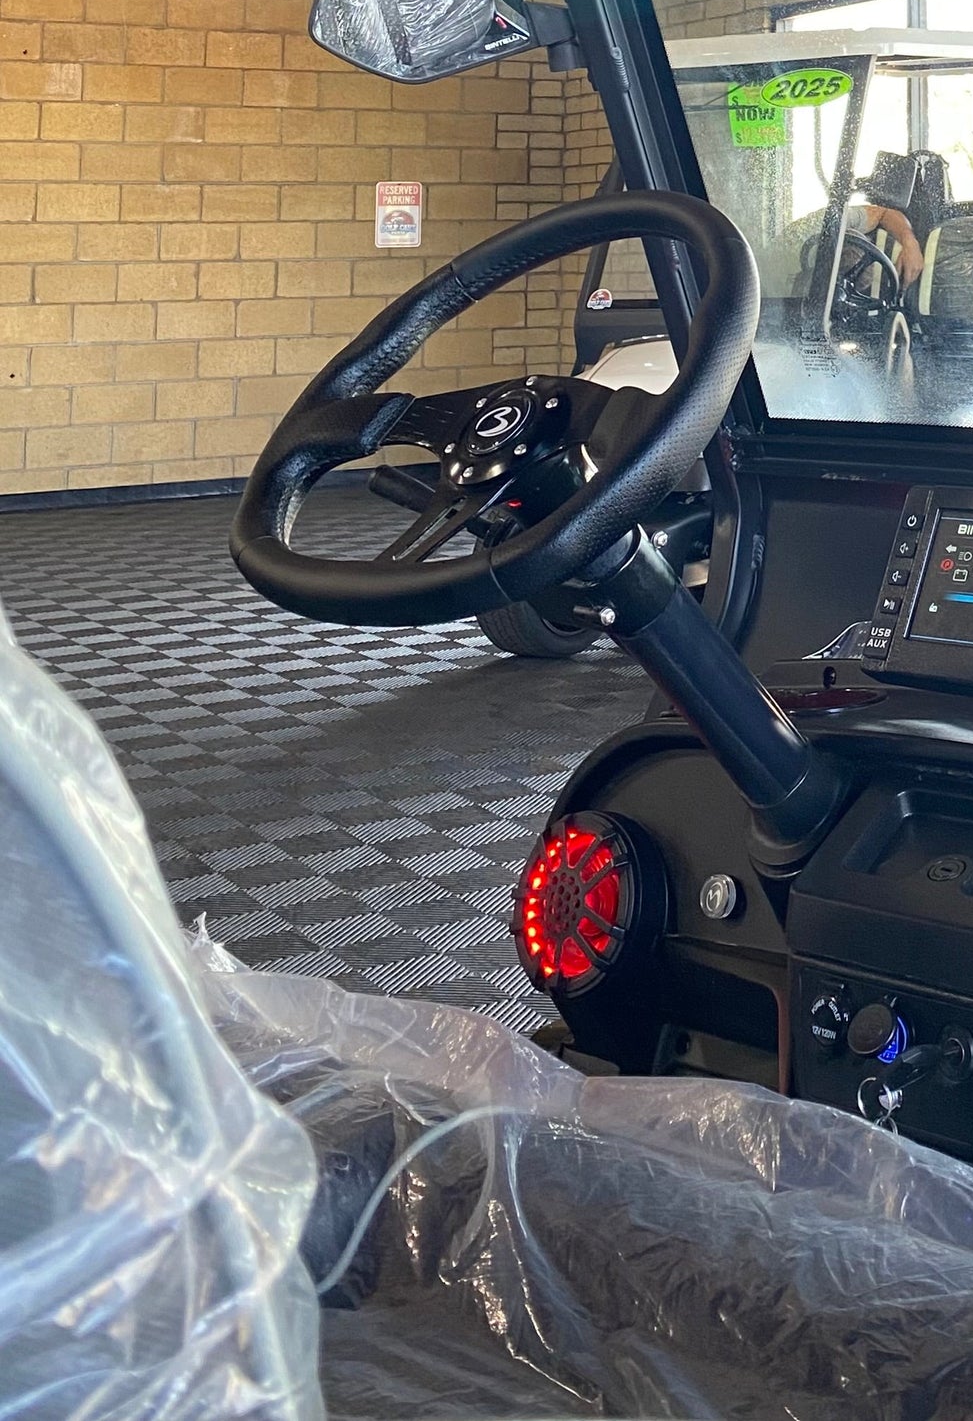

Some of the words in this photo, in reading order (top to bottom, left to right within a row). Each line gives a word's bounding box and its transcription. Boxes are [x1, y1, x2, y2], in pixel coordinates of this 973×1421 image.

[769, 76, 844, 102] 2025
[736, 107, 776, 122] NOW
[379, 185, 419, 195] RESERVED
[383, 195, 416, 205] PARKING
[870, 626, 892, 637] USB
[866, 638, 888, 649] AUX
